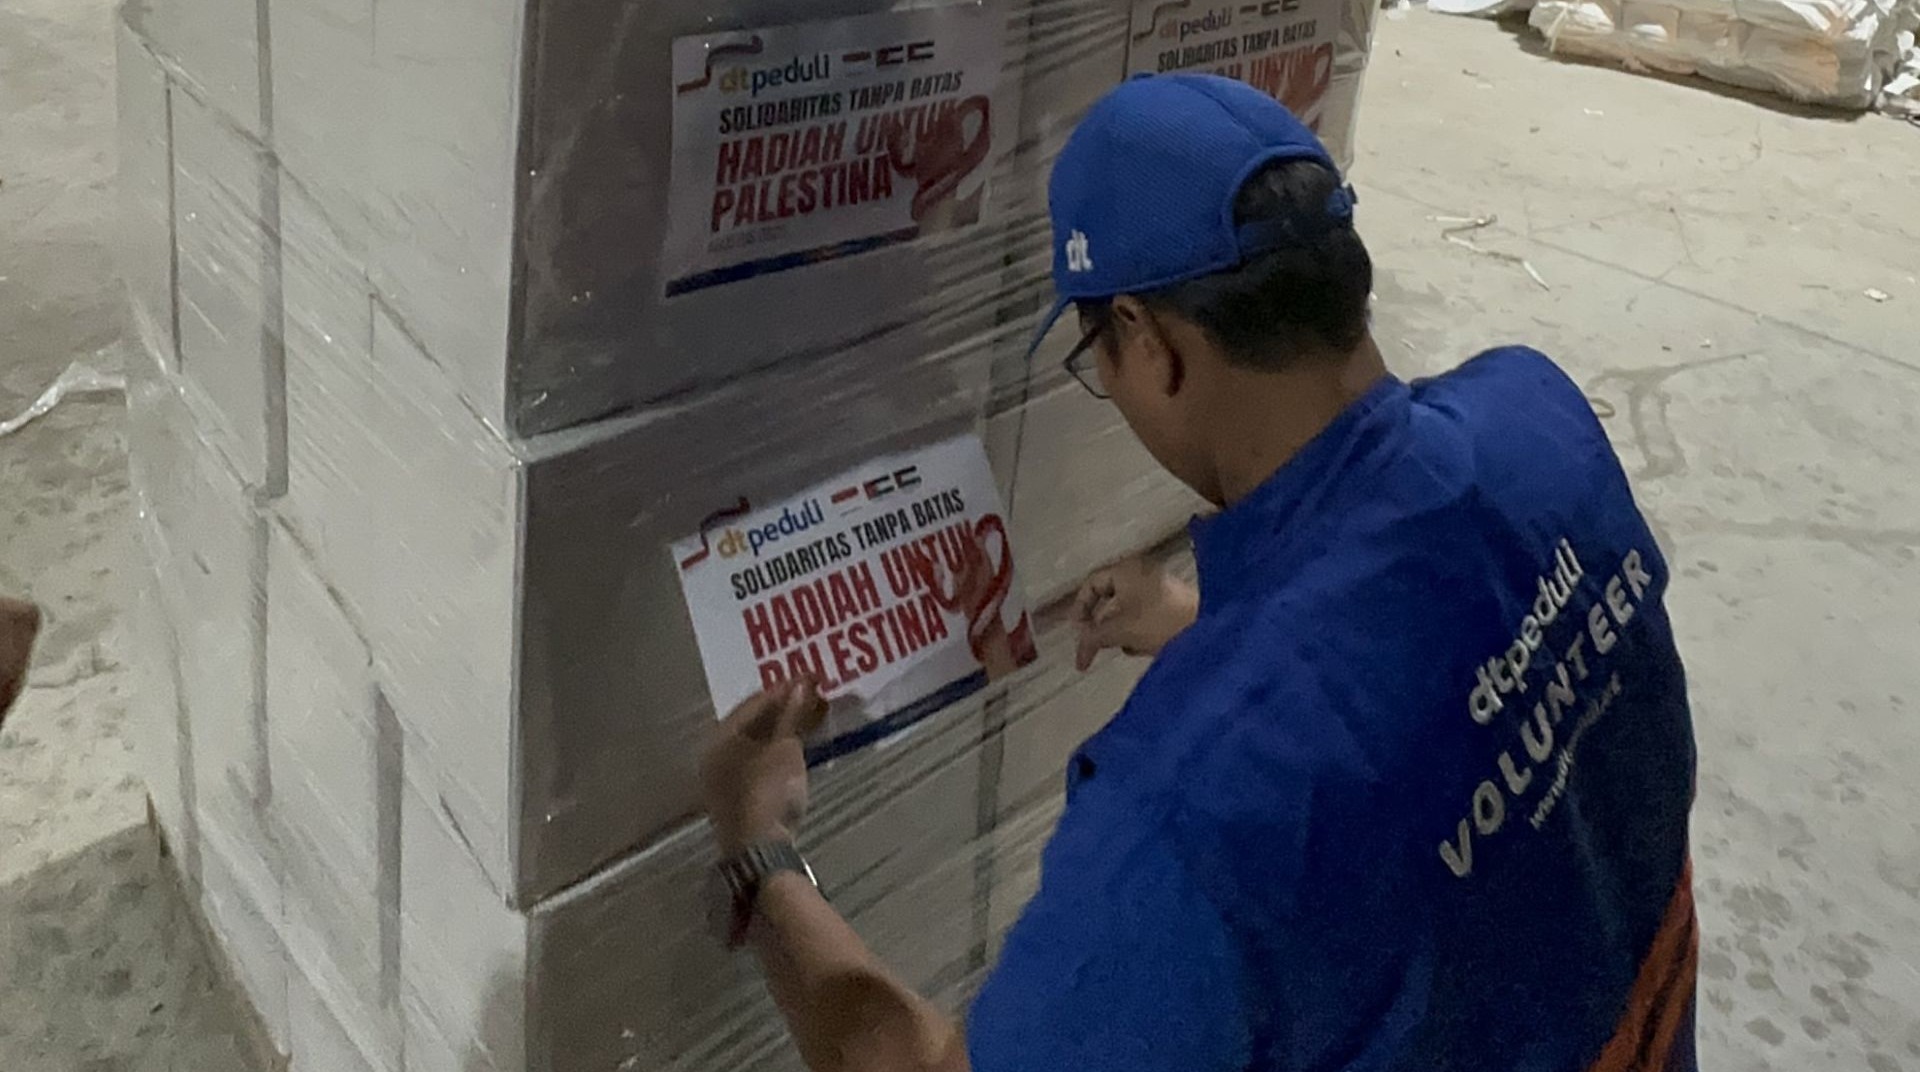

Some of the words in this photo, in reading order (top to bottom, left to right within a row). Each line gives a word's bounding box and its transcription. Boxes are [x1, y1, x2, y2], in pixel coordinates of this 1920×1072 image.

[718, 53, 830, 97] dtpeduli
[1157, 36, 1238, 73] SOLIDARITAS
[1242, 27, 1279, 55] TANPA
[1282, 19, 1317, 45] BATAS
[718, 92, 842, 134] SOLIDARITAS
[850, 80, 905, 111] TANPA
[910, 71, 963, 99] BATAS
[716, 121, 847, 186] HADIAH
[710, 153, 893, 233] PALESTINA
[716, 499, 824, 558] dtpeduli
[730, 532, 851, 601] SOLIDARITAS
[851, 508, 912, 550] TANPA
[911, 488, 965, 528] BATAS
[742, 560, 882, 659] HADIAH
[1469, 537, 1585, 725] dtpeduli
[1438, 549, 1652, 878] VOLUNTEER
